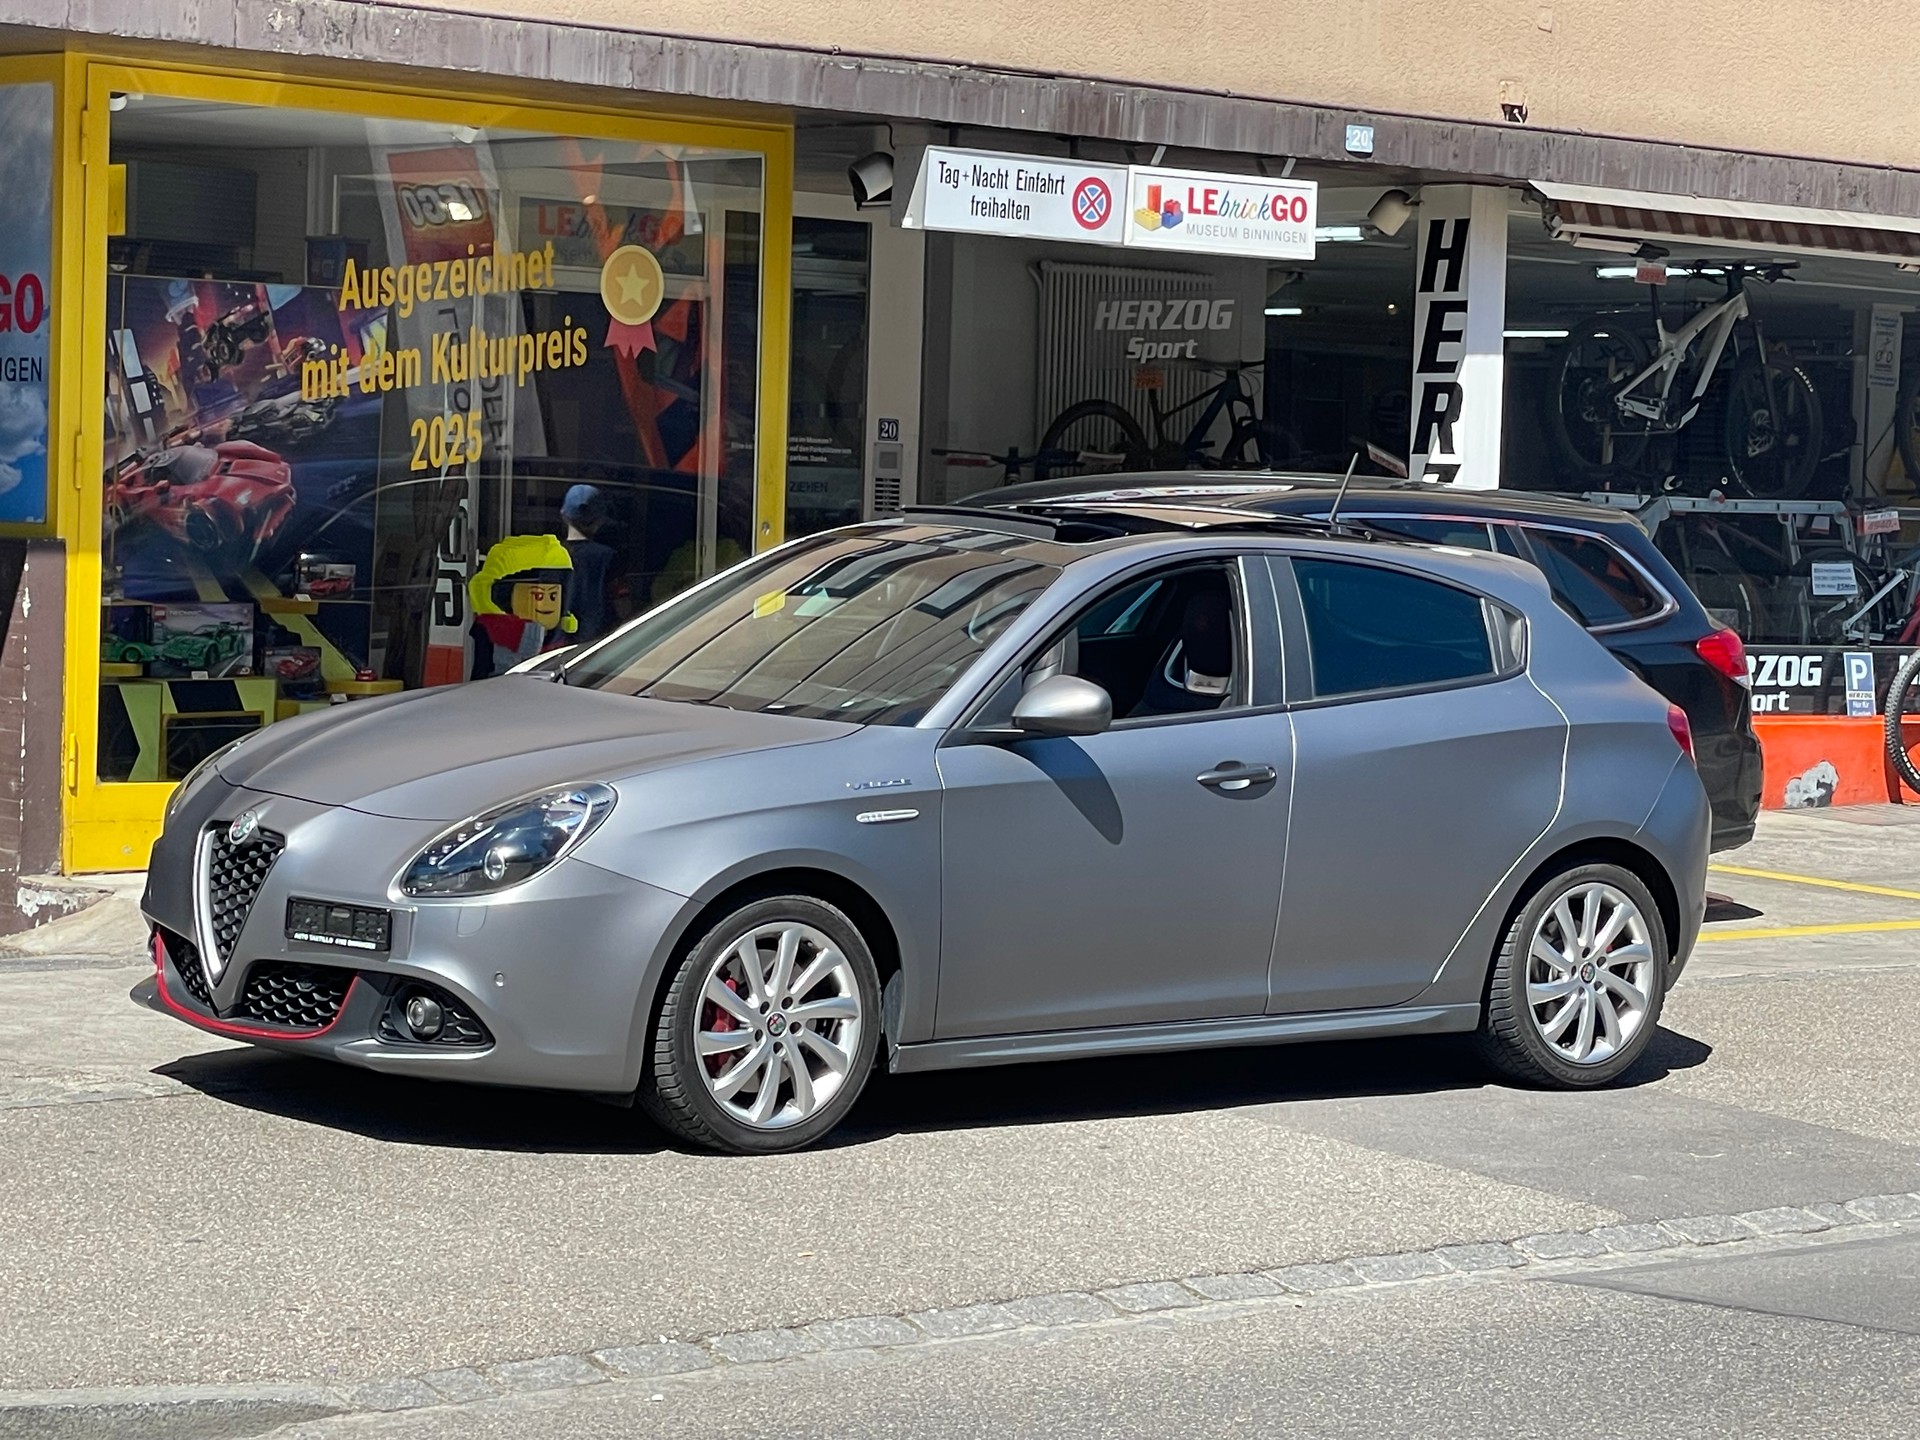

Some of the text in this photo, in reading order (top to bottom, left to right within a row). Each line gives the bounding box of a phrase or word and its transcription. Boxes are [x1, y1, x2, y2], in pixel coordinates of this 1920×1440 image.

[1351, 129, 1369, 147] 20
[1016, 169, 1065, 195] Einfahrt
[970, 195, 1030, 221] freihalten
[1187, 187, 1308, 223] LEbrickGO
[1186, 223, 1307, 244] MUSEUM BINNINGEN
[339, 240, 554, 318] Ausgezeichnet
[1093, 299, 1235, 331] HERZOG
[302, 344, 350, 402] mit
[358, 336, 422, 395] dem
[431, 315, 588, 388] Kulturpreis
[1126, 337, 1198, 364] Sport
[1410, 217, 1471, 484] HER
[0, 356, 42, 382] GEN
[410, 411, 483, 472] 2025
[880, 421, 897, 439] 20
[1850, 658, 1868, 690] P
[1751, 691, 1790, 711] ort
